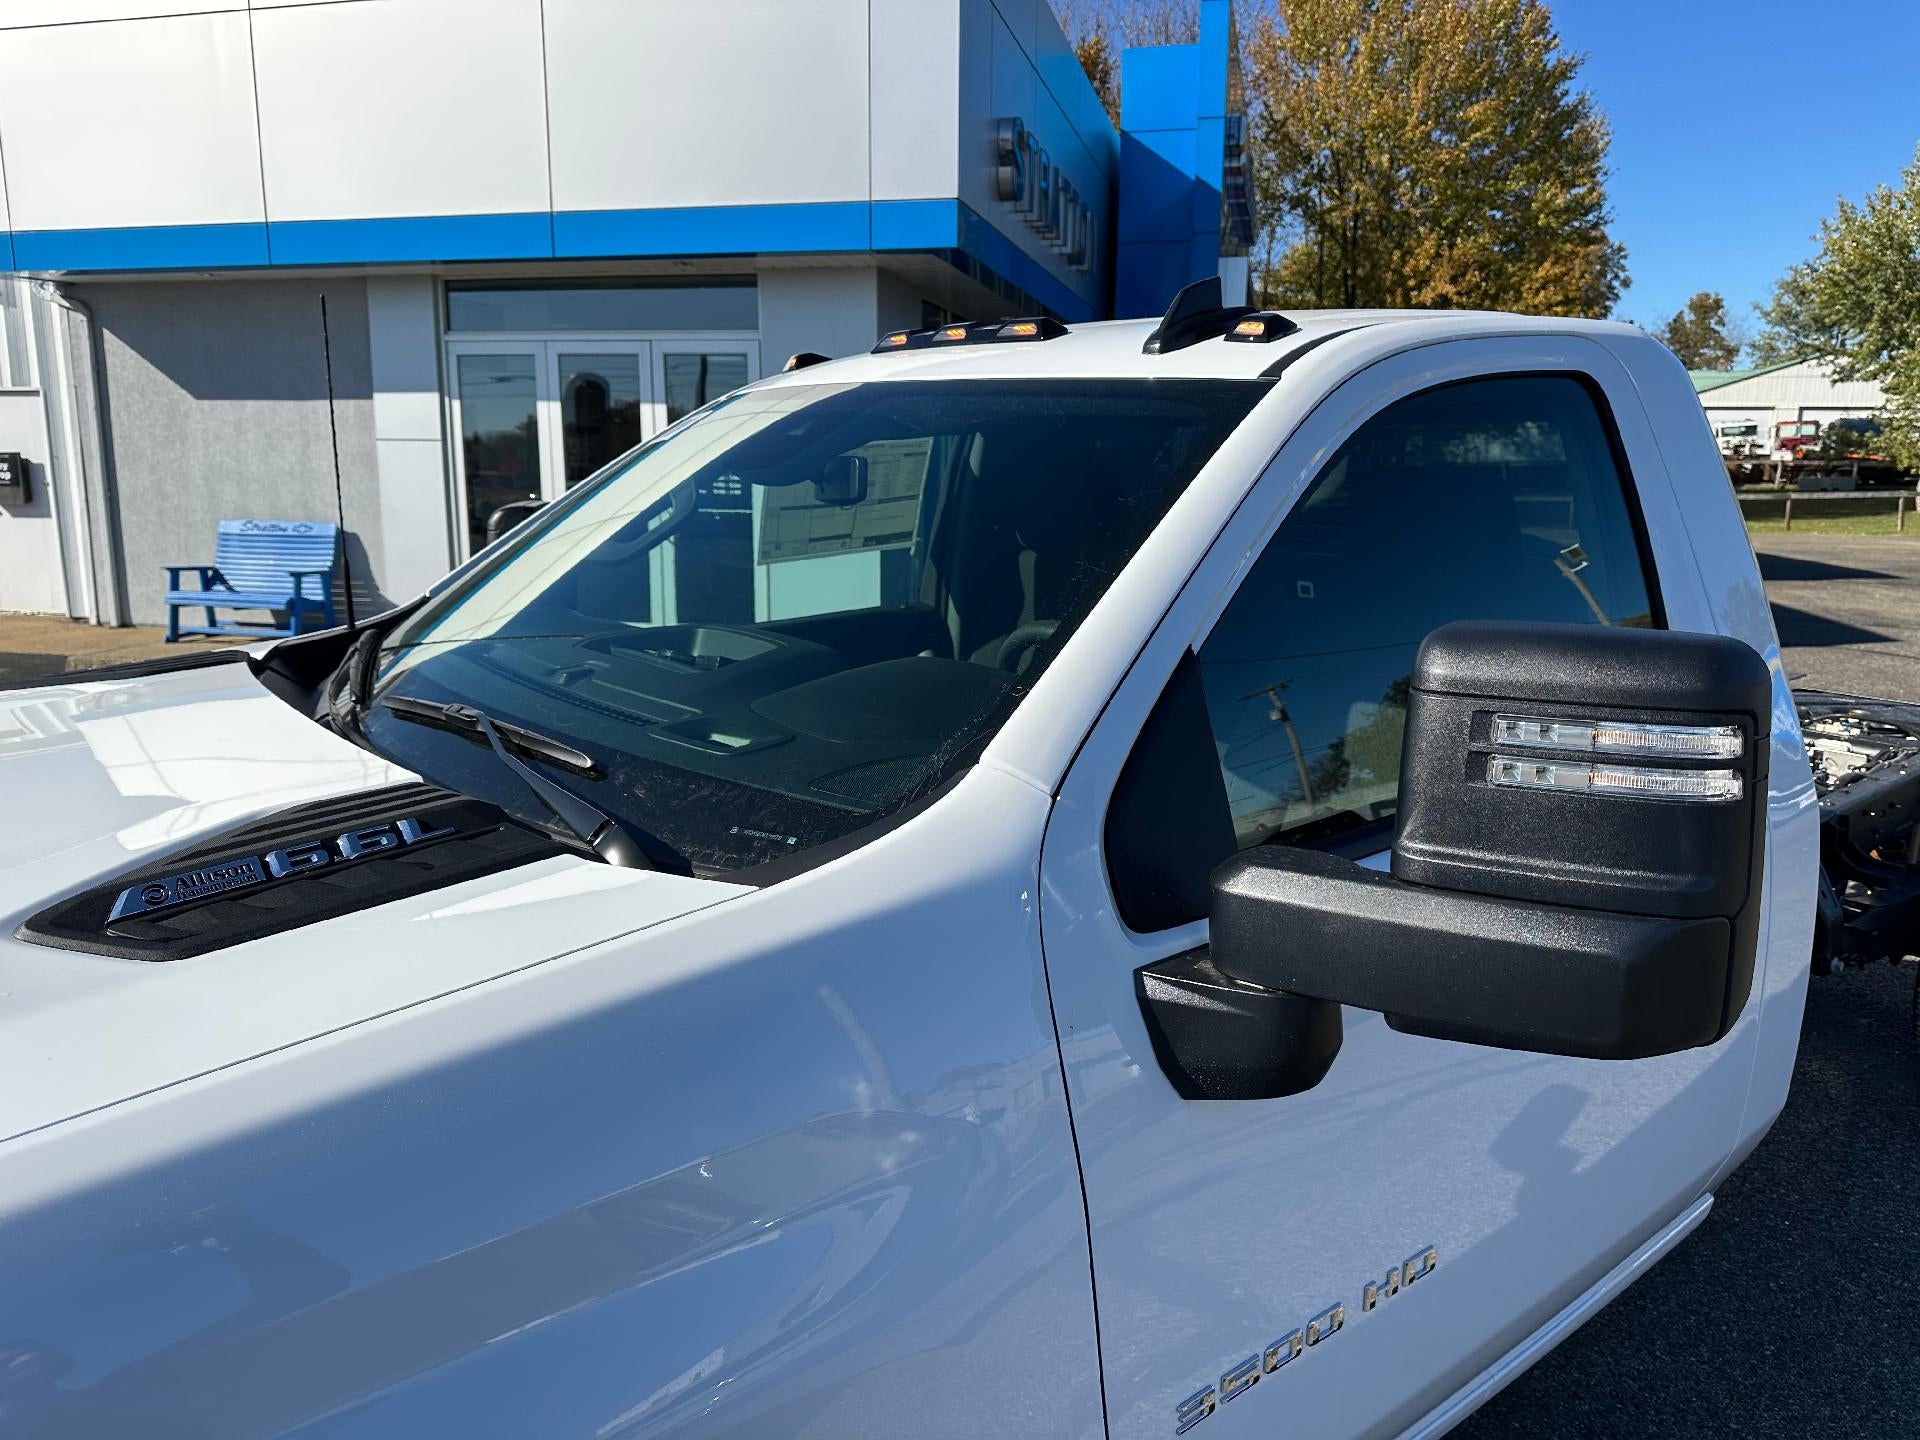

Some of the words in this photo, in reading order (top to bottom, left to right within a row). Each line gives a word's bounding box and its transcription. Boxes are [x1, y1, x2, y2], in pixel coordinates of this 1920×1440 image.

[174, 873, 259, 901] Transmission
[175, 863, 255, 891] Allison
[1175, 1301, 1345, 1437] 3500
[1361, 1244, 1440, 1313] HD
